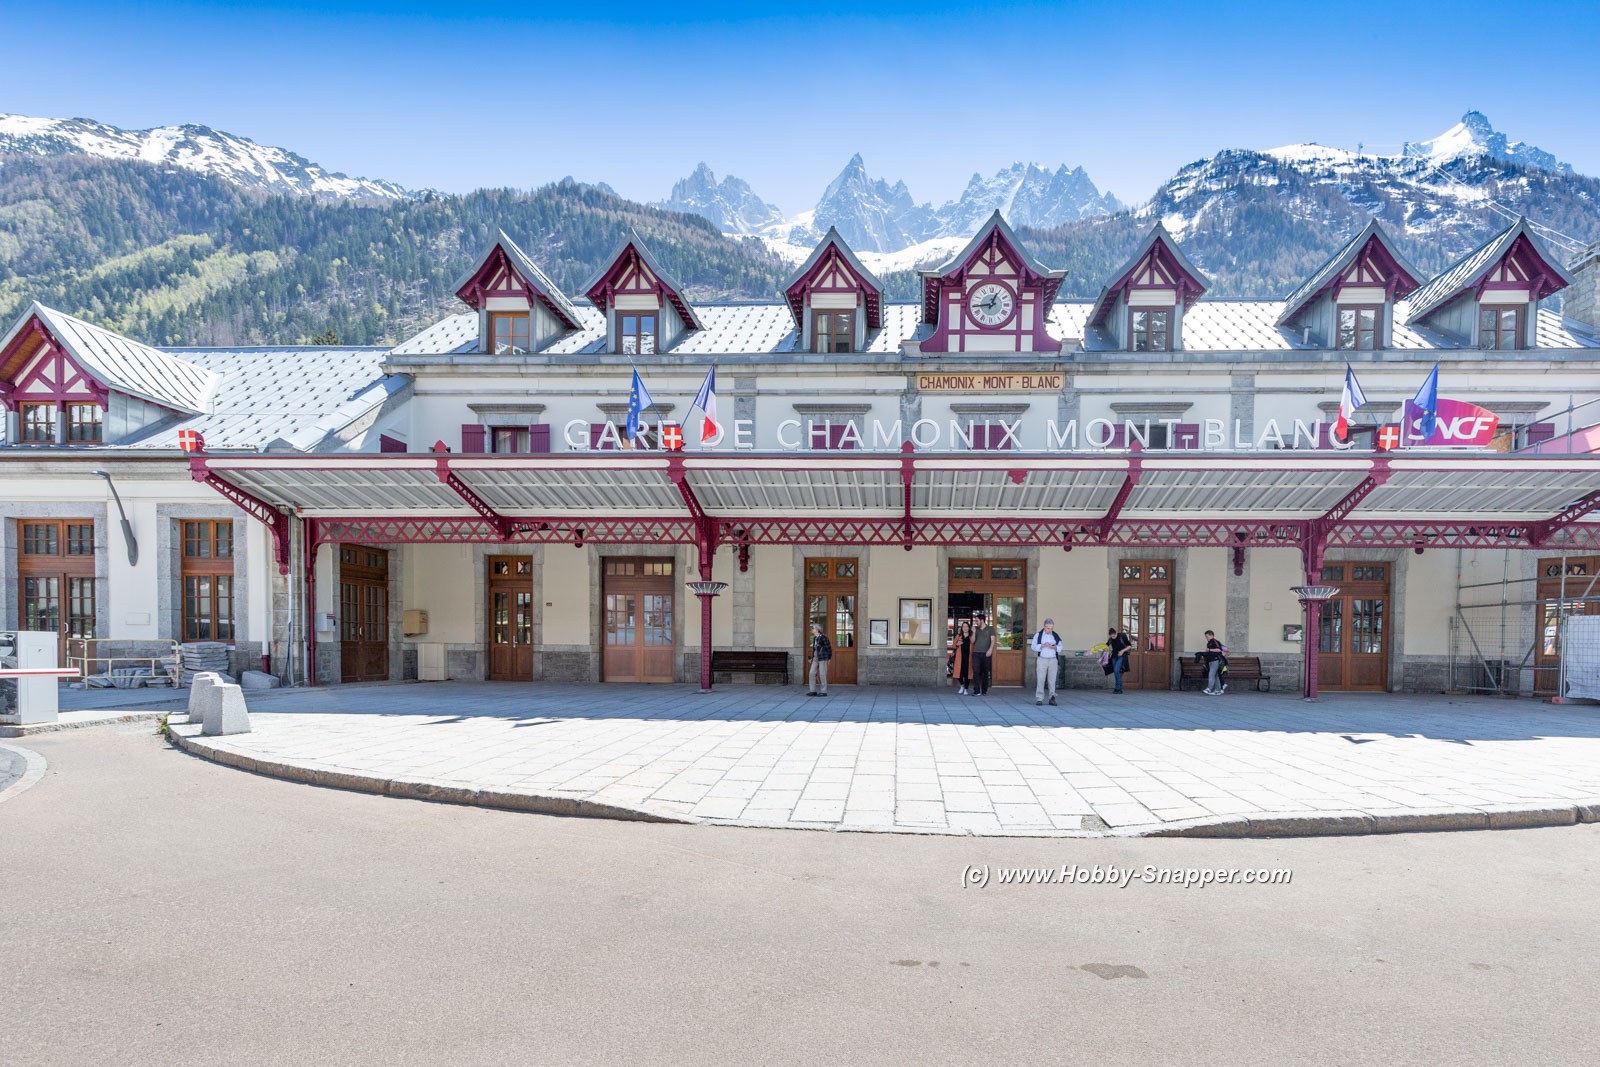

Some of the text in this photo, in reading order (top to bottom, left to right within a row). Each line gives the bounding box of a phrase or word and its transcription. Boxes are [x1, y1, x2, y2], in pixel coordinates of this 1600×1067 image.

[920, 376, 975, 389] CHAMONIX
[983, 376, 1014, 389] MONT
[1022, 376, 1060, 389] BLANC
[700, 419, 754, 449] DE
[776, 418, 1022, 449] CHAMONIX
[1407, 416, 1495, 441] SNCF
